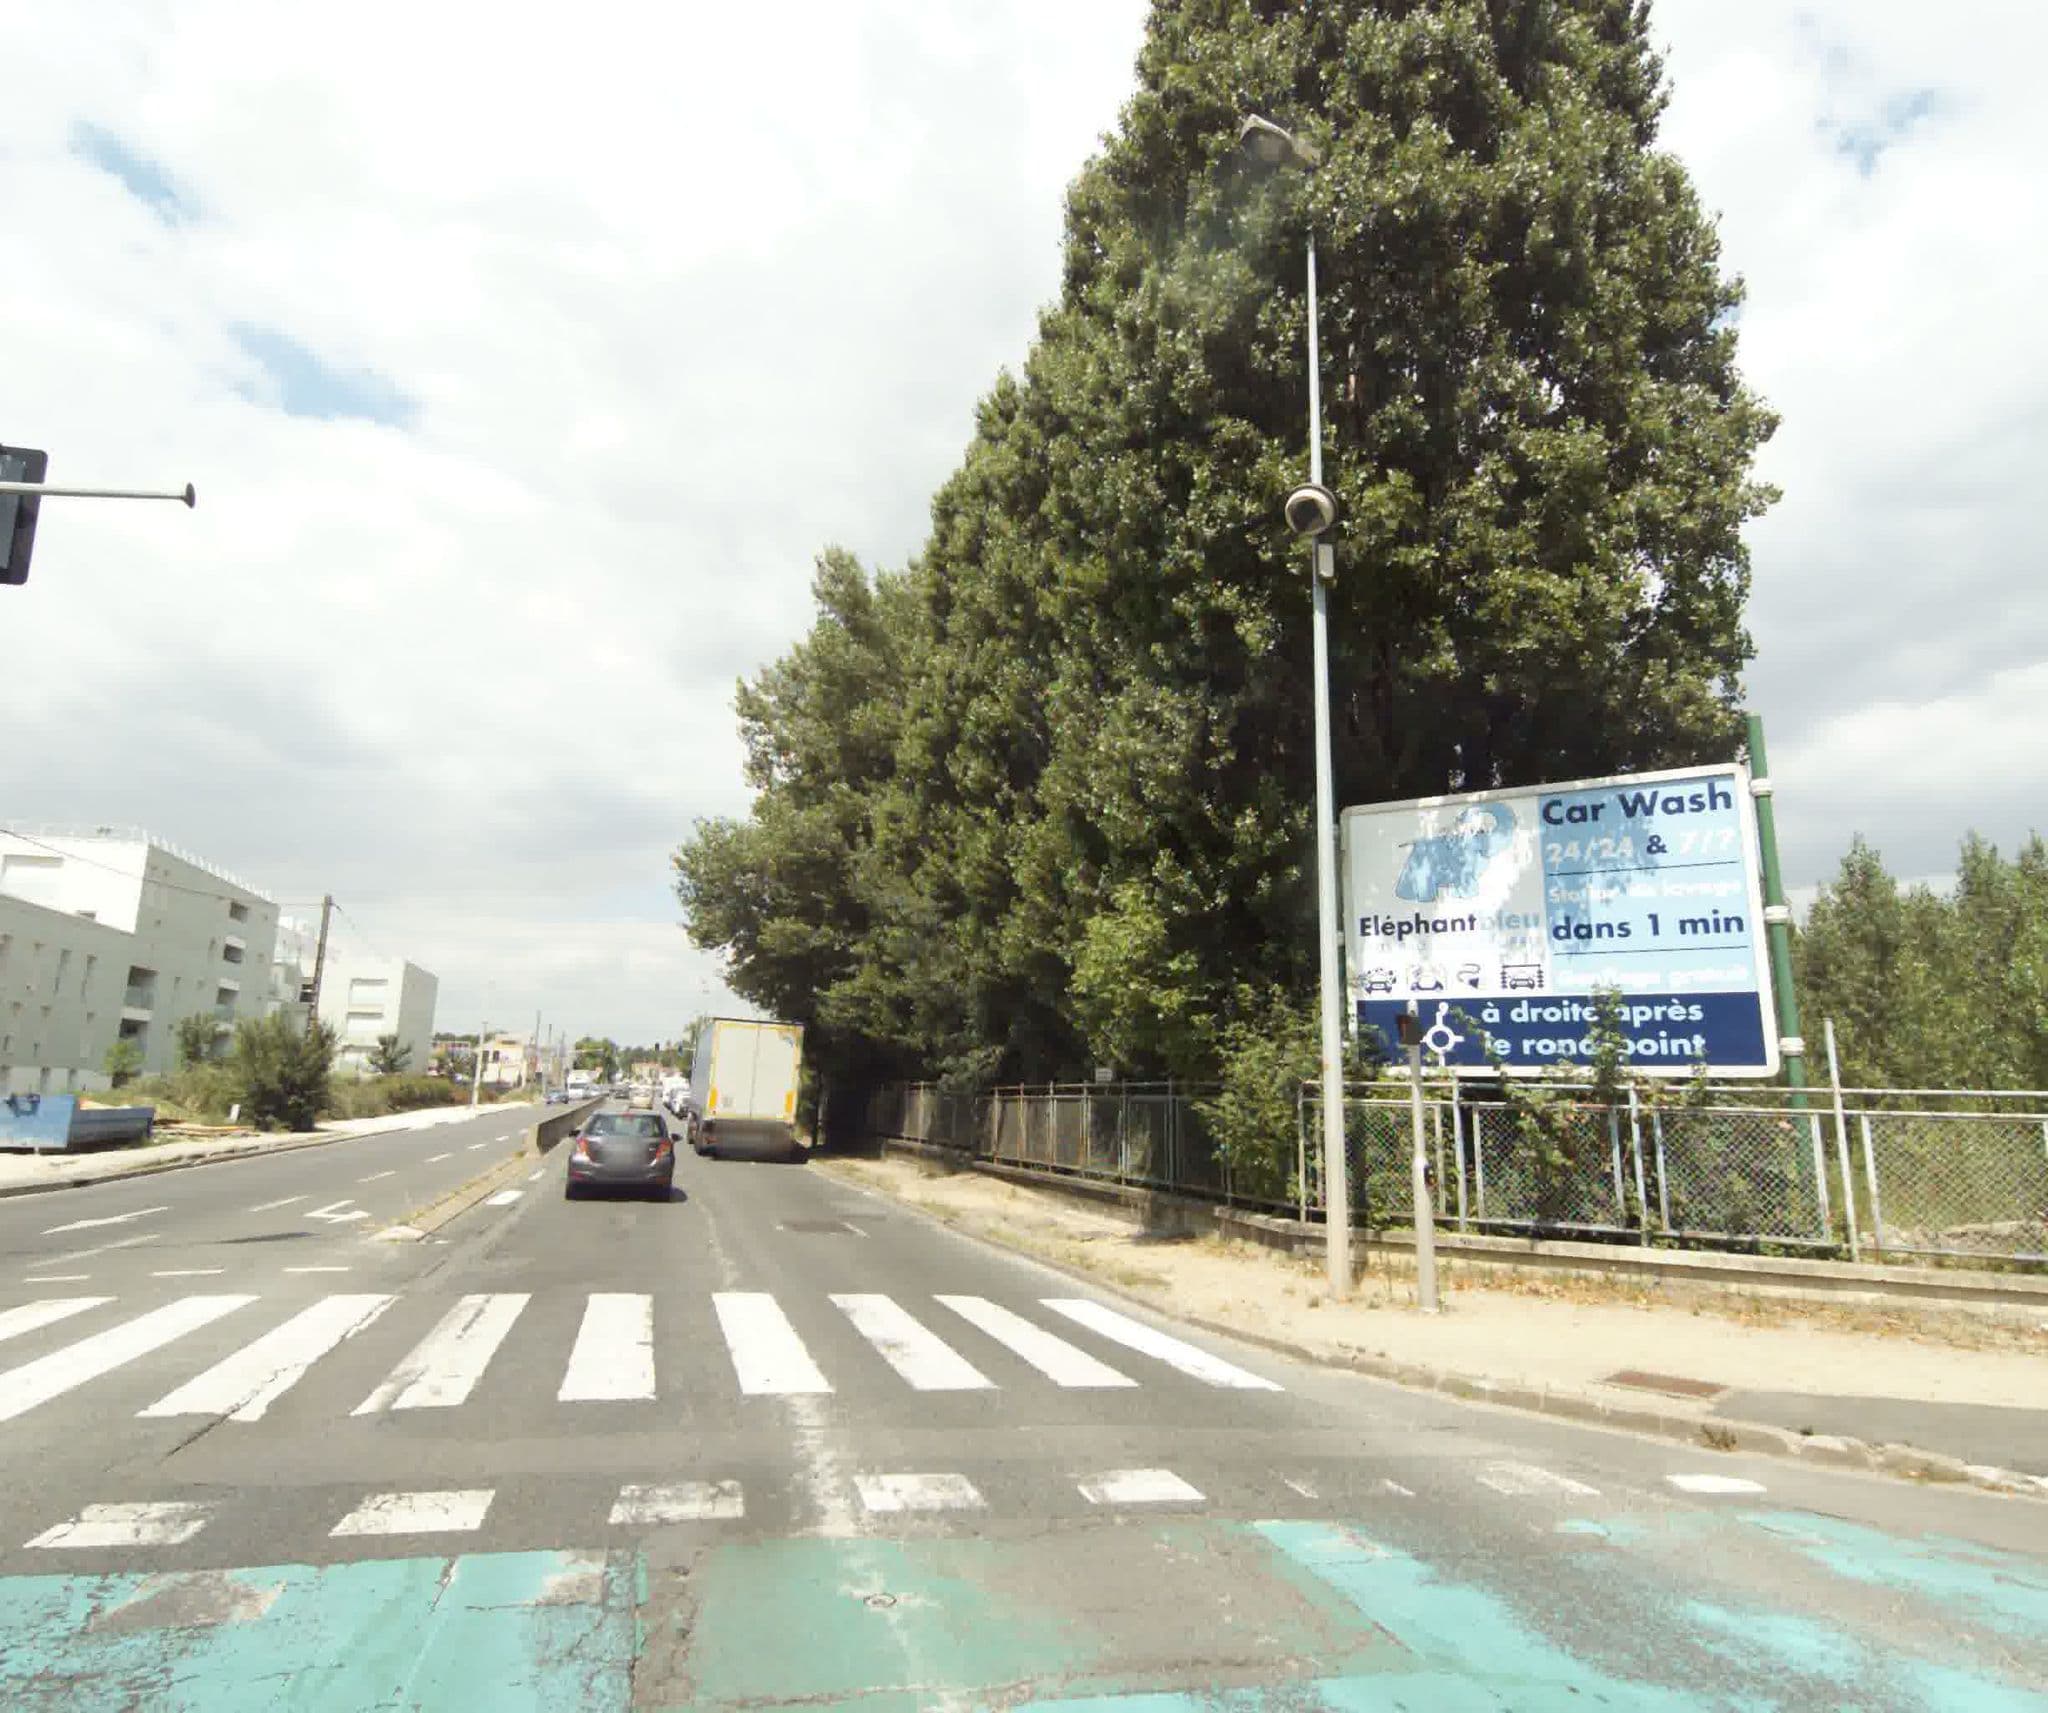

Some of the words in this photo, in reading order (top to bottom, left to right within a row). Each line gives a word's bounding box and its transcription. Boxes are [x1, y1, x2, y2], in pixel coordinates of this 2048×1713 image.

[1542, 799, 1606, 826] Car
[1617, 782, 1732, 820] Wash
[1646, 834, 1668, 856] &
[1360, 912, 1478, 942] Eléphant
[1552, 915, 1632, 941] dans
[1647, 913, 1661, 937] 1
[1678, 908, 1745, 936] min
[1481, 1001, 1500, 1023] à
[1510, 999, 1600, 1023] droite
[1614, 998, 1704, 1028] après
